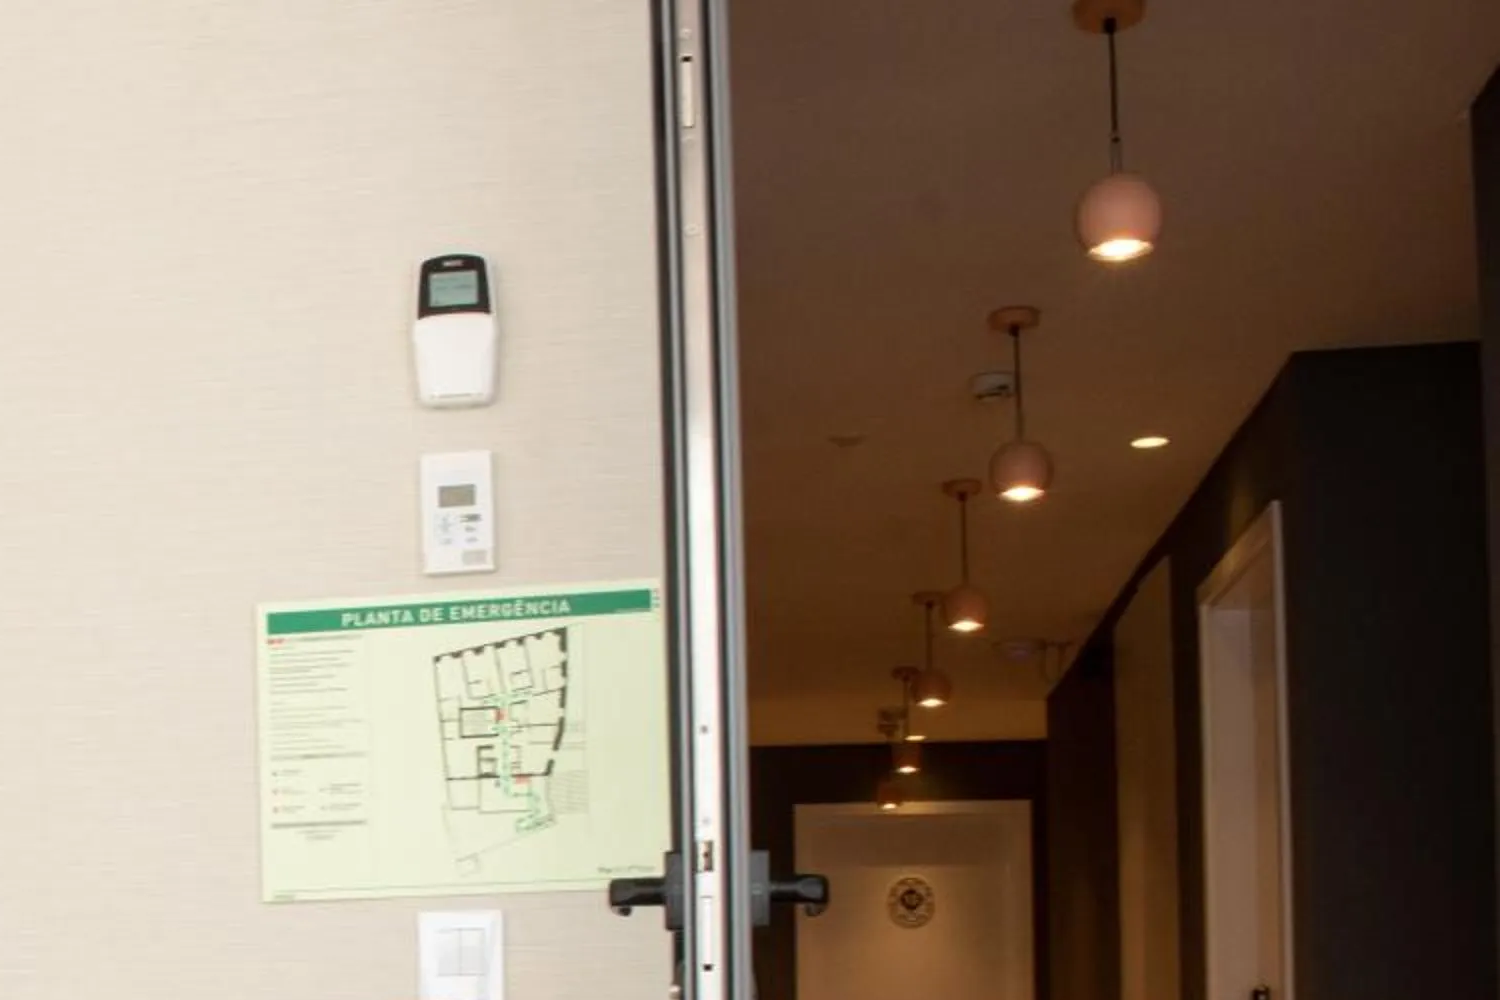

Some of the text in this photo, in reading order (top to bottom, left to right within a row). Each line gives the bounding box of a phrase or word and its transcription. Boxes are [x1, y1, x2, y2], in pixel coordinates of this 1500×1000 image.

[341, 599, 571, 627] PLANTA DE EMERGÊNCIA
